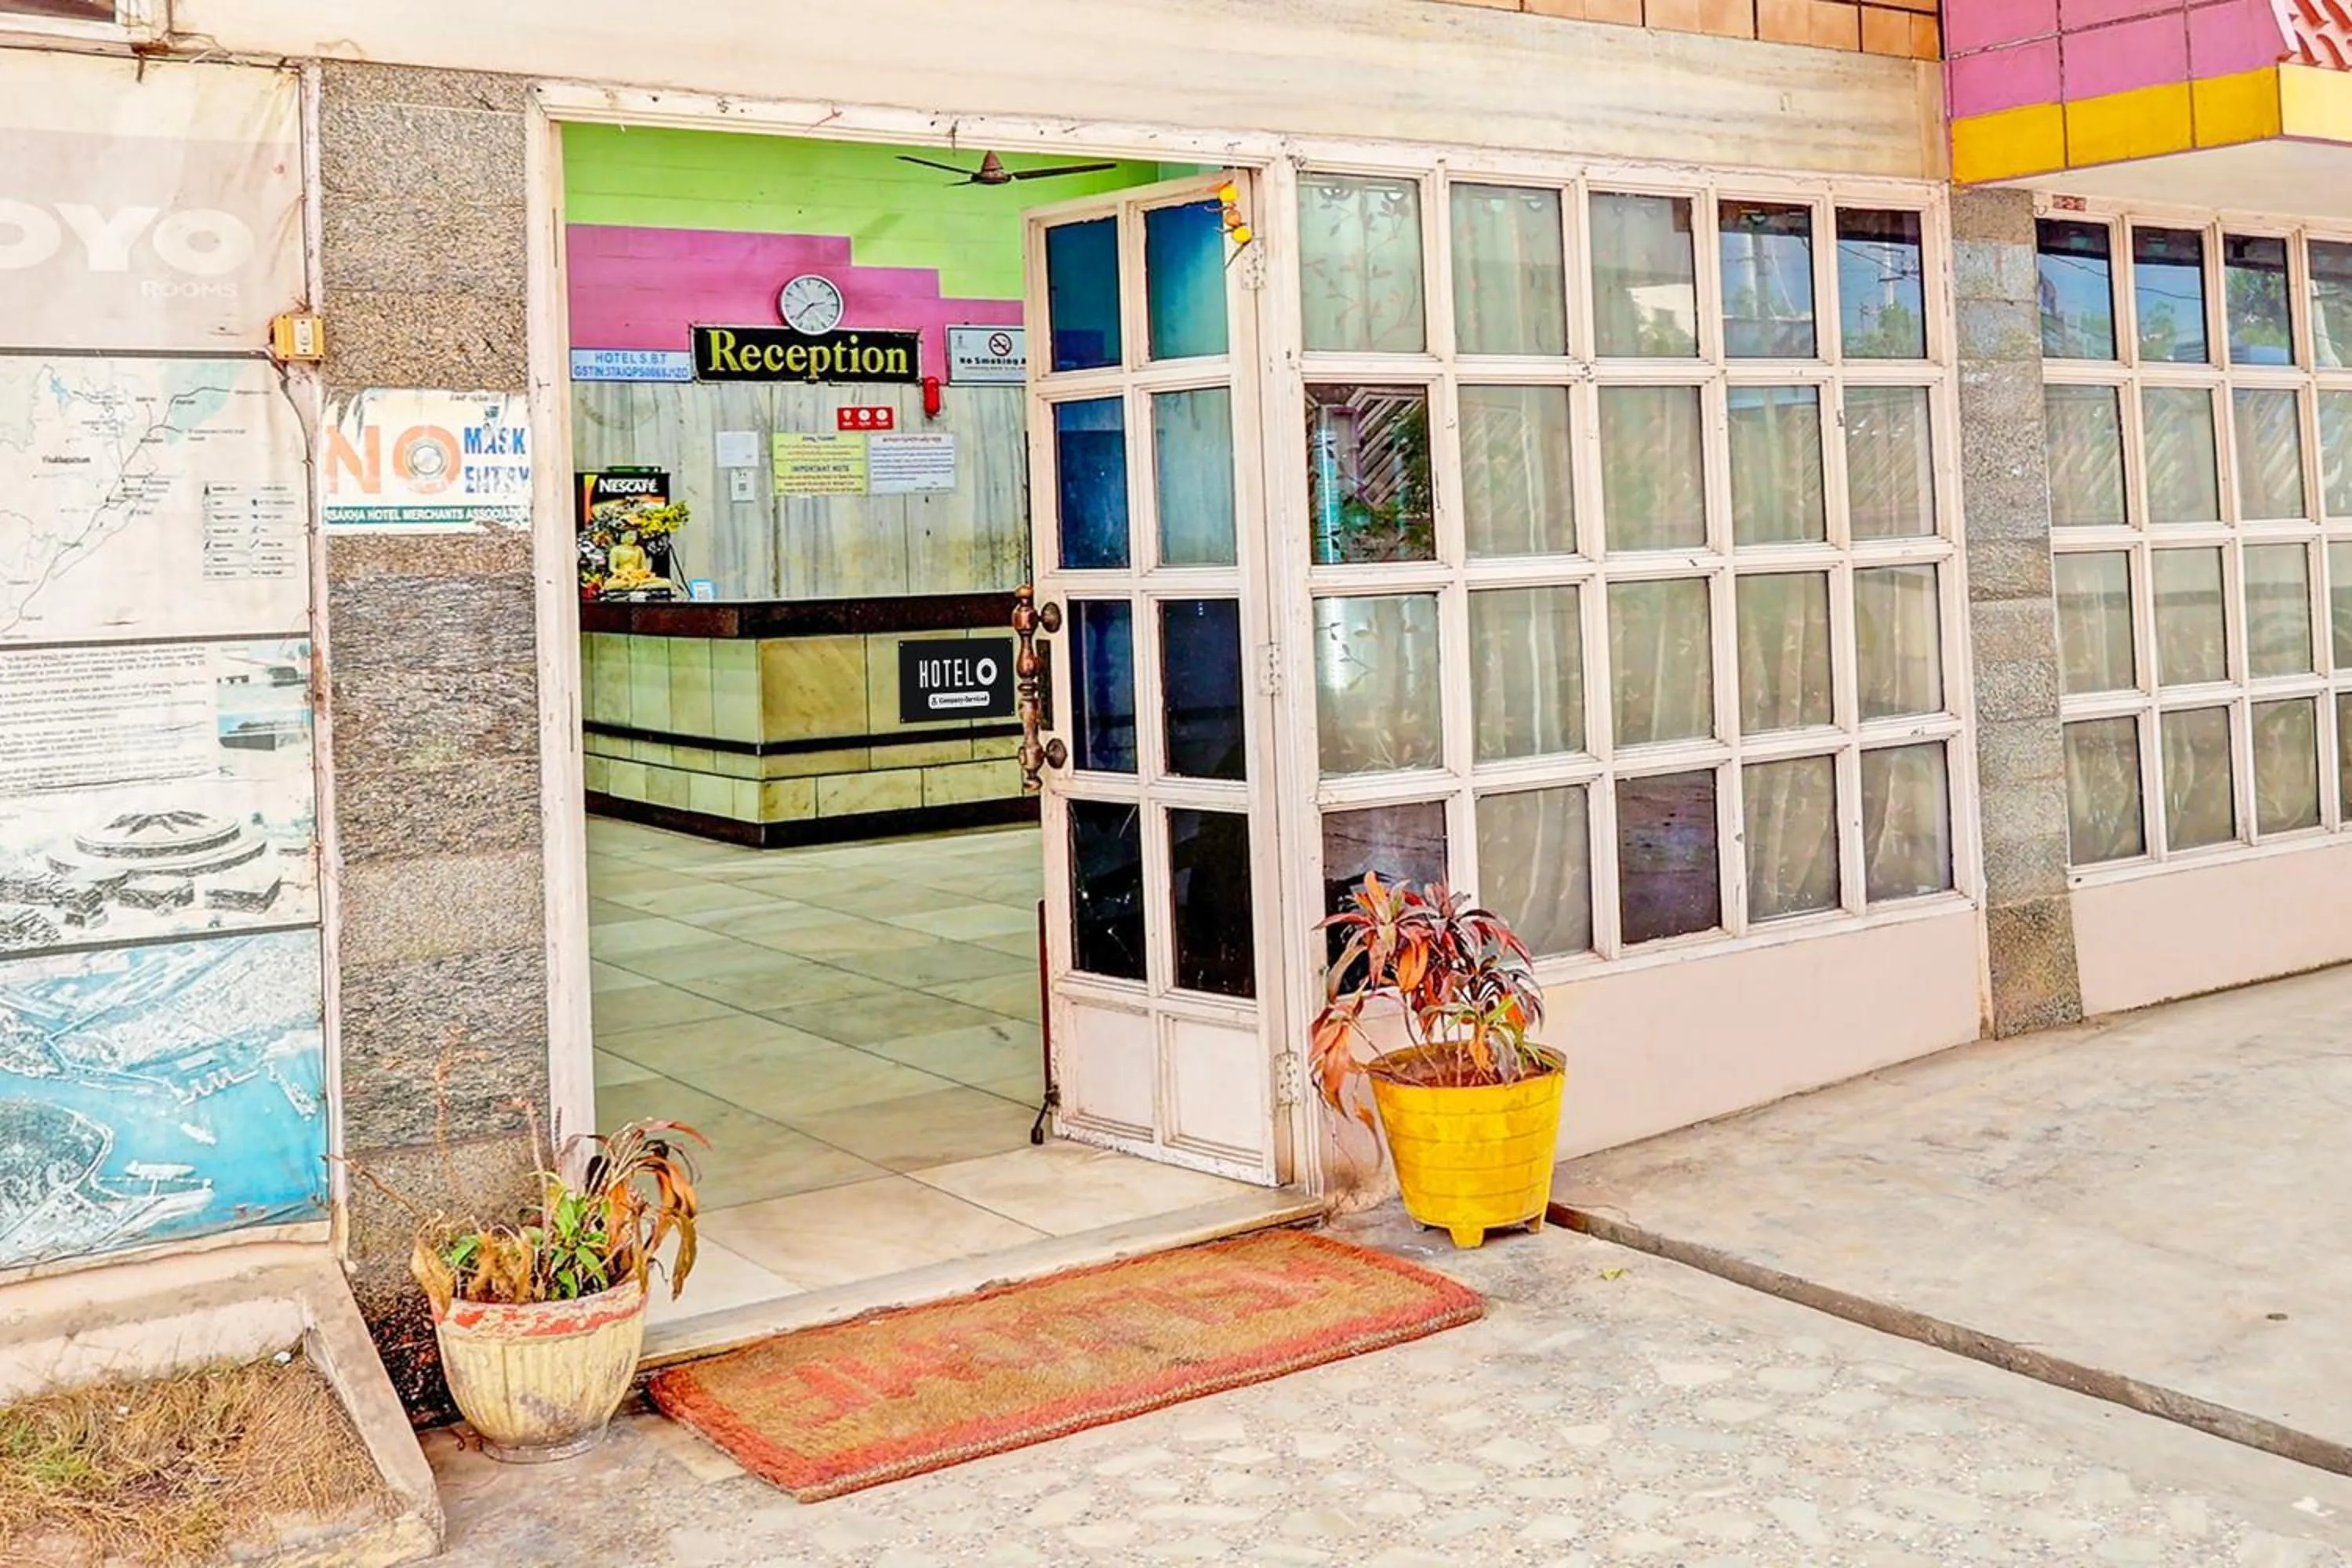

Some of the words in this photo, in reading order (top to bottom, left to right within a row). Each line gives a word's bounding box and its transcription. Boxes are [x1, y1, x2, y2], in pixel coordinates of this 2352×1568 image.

[140, 281, 238, 299] ROOMS
[595, 353, 637, 364] HOTEL
[706, 328, 908, 377] Reception
[464, 427, 526, 454] MASK
[326, 424, 462, 494] NO
